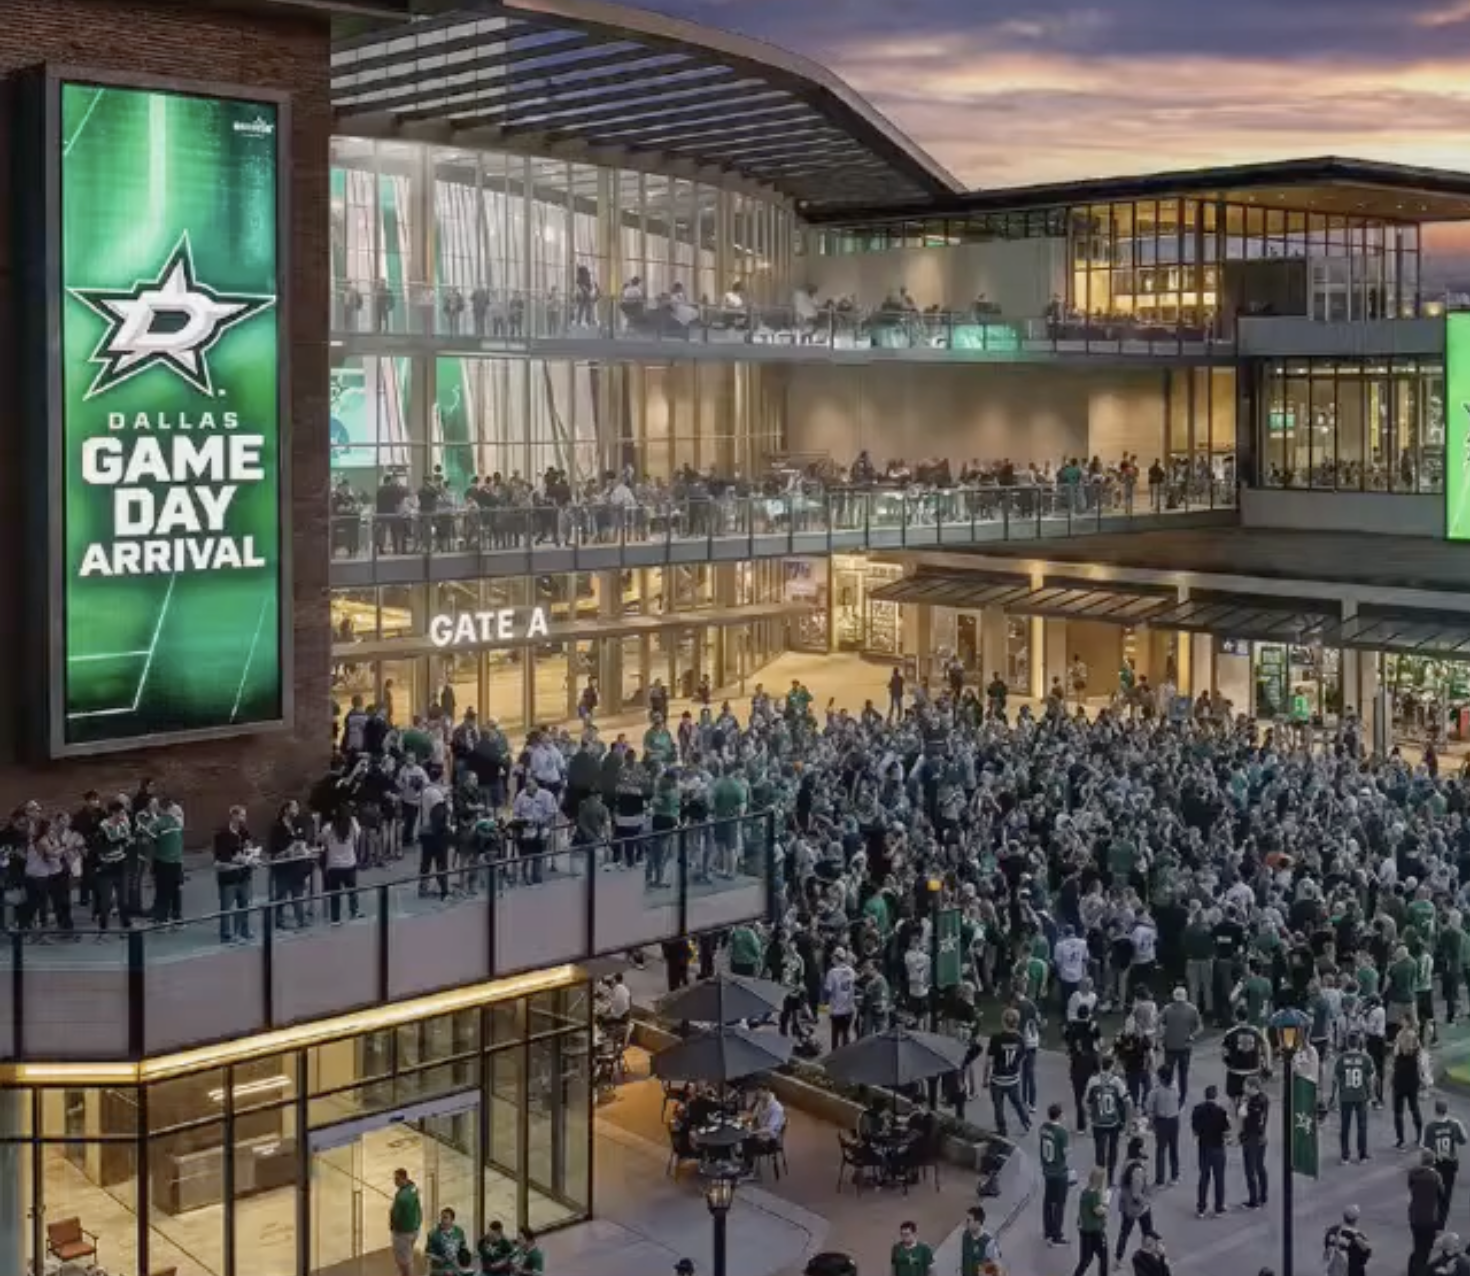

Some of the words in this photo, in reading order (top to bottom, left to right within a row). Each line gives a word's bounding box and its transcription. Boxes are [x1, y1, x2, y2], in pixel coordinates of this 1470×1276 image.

[109, 412, 238, 430] DALLAS
[82, 434, 265, 484] GAME
[114, 485, 237, 536] DAY
[79, 536, 266, 576] ARRIVAL
[429, 608, 515, 647] GATE
[526, 606, 549, 638] A
